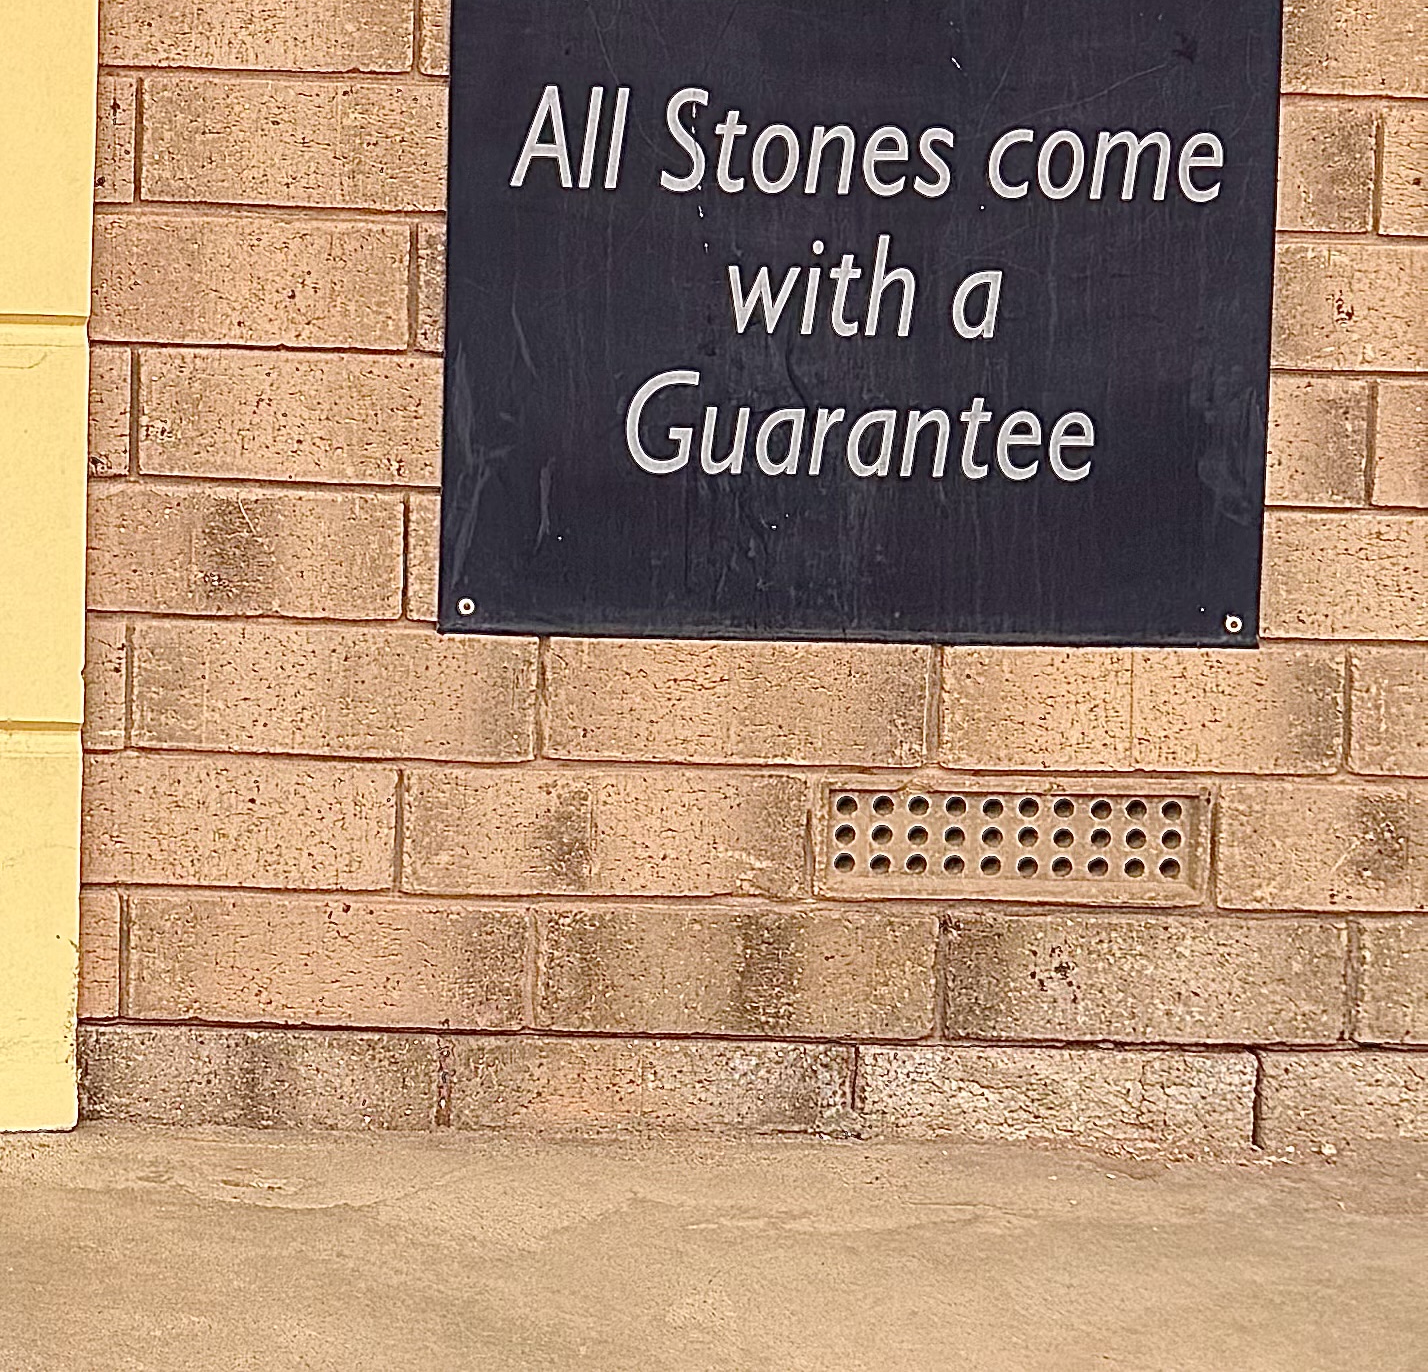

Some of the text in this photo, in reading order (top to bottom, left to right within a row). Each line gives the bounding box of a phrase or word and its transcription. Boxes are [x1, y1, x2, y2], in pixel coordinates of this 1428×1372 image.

[509, 85, 1226, 203] All Stones come
[727, 234, 1003, 340] with a
[624, 369, 1096, 482] Guarantee
